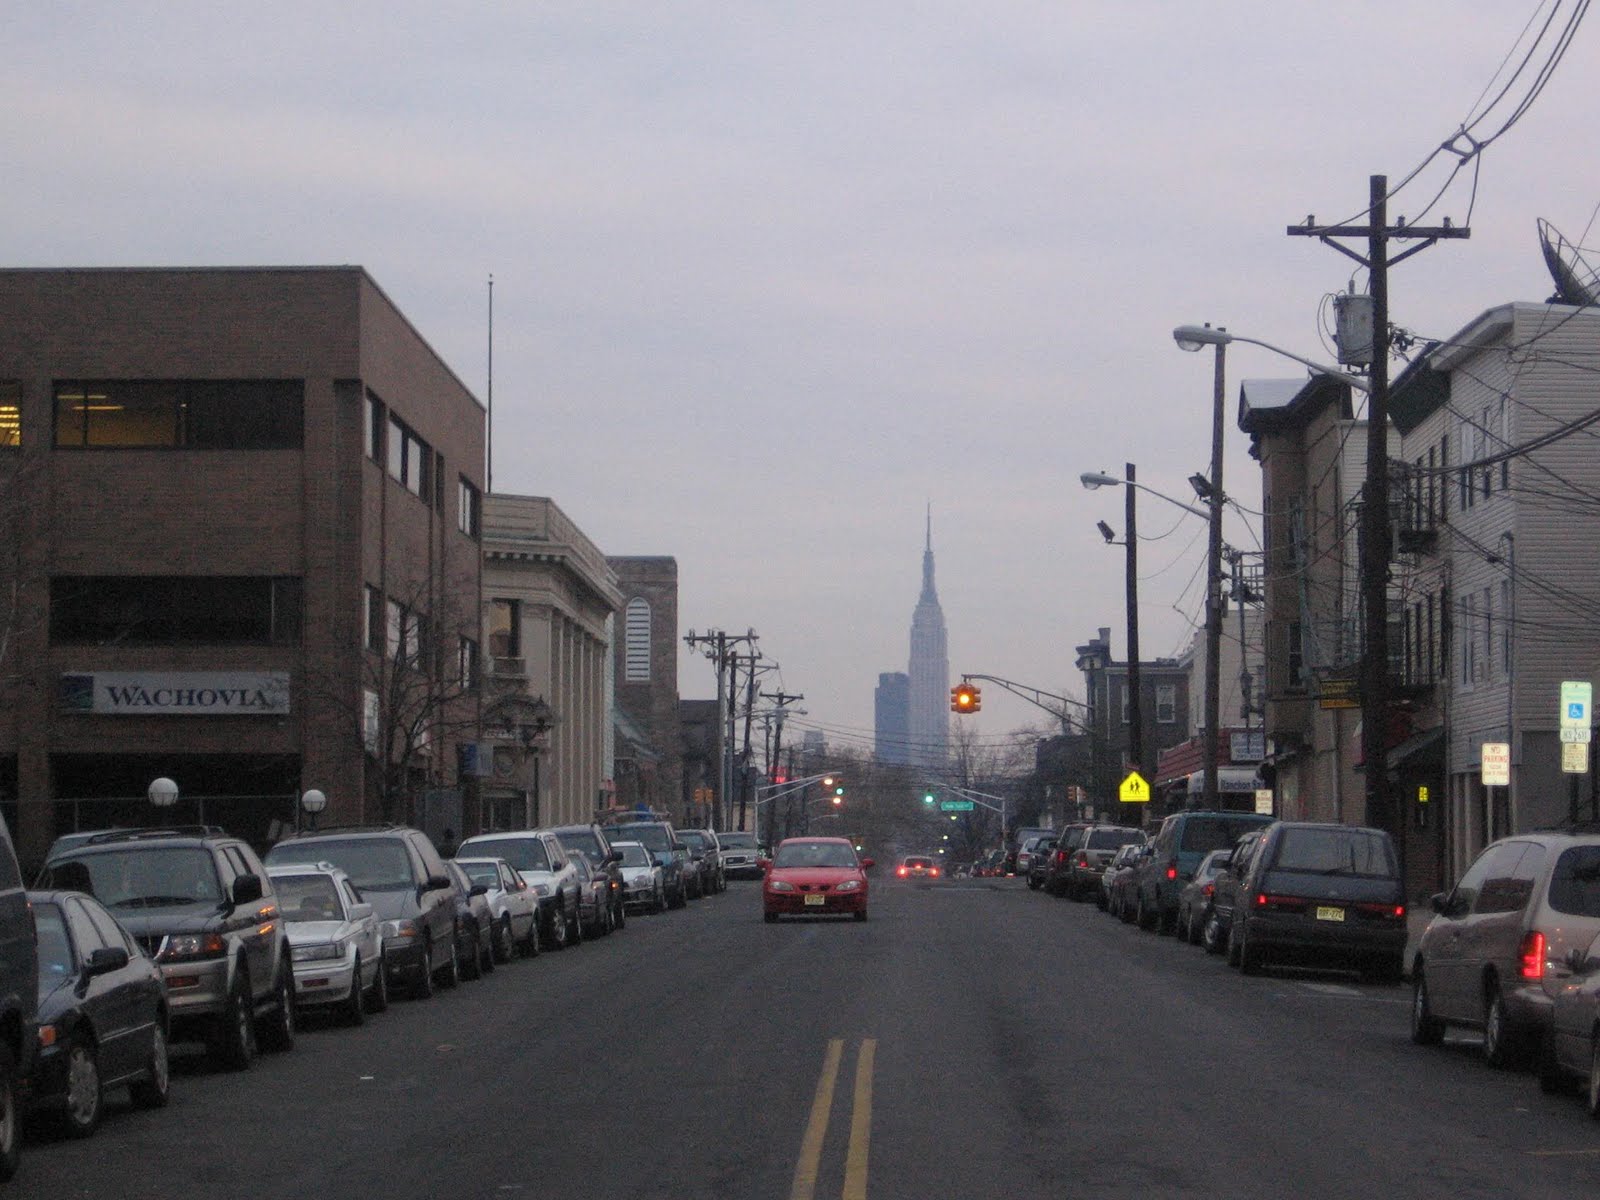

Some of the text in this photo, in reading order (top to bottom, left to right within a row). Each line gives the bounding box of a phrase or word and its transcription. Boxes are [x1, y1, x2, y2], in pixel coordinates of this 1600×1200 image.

[106, 686, 272, 707] WACHOVIA
[1490, 746, 1501, 754] NO
[1484, 755, 1508, 763] PARKING
